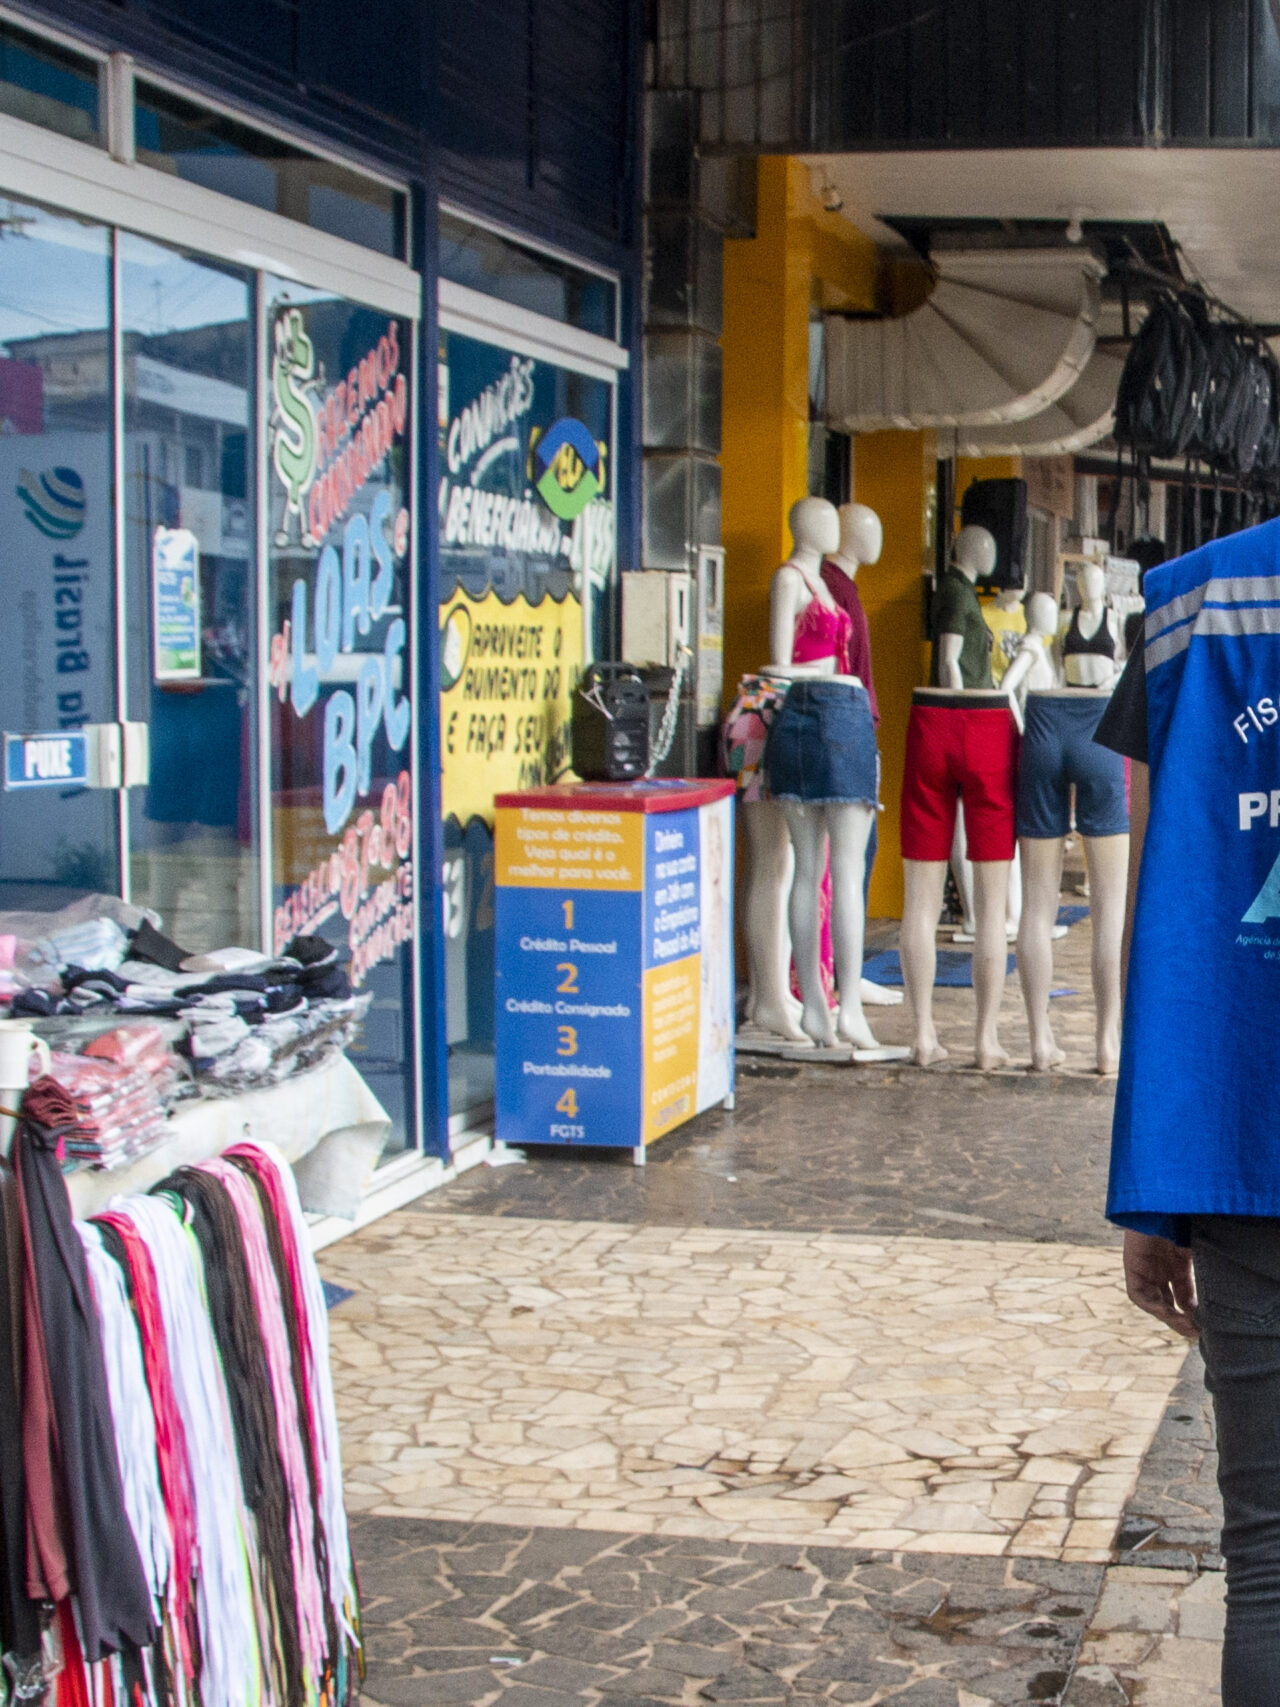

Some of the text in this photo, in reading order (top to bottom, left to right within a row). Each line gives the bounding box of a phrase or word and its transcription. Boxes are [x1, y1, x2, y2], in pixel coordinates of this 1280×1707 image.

[290, 491, 395, 718] LOAS
[470, 624, 544, 659] APROVEITE
[463, 665, 538, 700] AUMENTO
[323, 618, 411, 836] BPC
[446, 709, 458, 755] E
[466, 713, 506, 761] FAÇA
[24, 738, 72, 779] PUXE
[520, 807, 622, 825] Temos diversos
[516, 828, 549, 841] tipos
[552, 829, 570, 841] de
[524, 845, 617, 863] Veja qual é o
[508, 864, 556, 879] melhor
[558, 867, 593, 881] para
[562, 900, 575, 930] 1
[519, 936, 618, 954] Crédito Pessoal
[1235, 934, 1272, 945] Agência
[1263, 951, 1276, 960] de
[556, 963, 580, 993] 2
[505, 998, 632, 1018] Crédito Consignado
[556, 1025, 579, 1056] 3
[522, 1061, 612, 1079] Portabilidade
[555, 1088, 580, 1119] 4
[550, 1124, 586, 1139] FGTS
